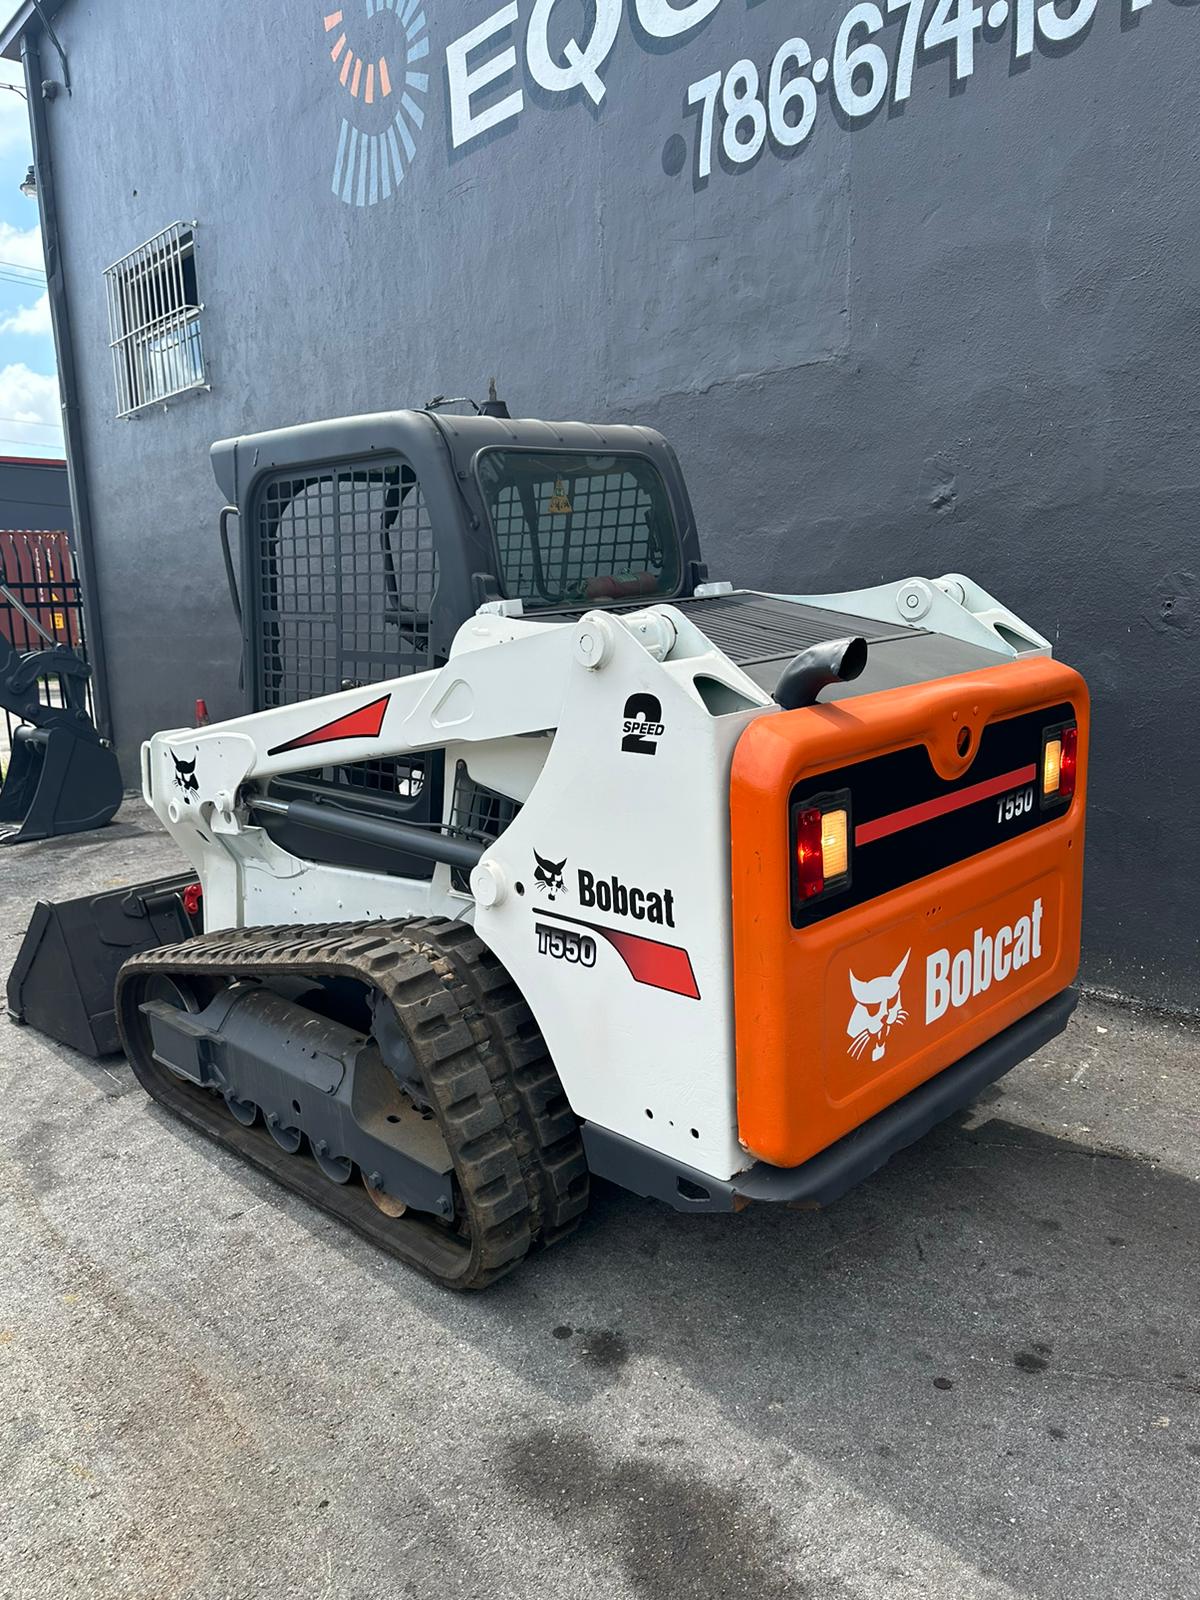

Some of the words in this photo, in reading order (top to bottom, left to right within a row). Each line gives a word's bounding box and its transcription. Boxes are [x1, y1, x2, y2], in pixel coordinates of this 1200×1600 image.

[621, 692, 662, 756] 2
[622, 720, 665, 736] SPEED
[997, 787, 1033, 824] T550
[578, 869, 675, 928] Bobcat
[535, 922, 597, 968] T550
[925, 897, 1043, 1026] Bobcat
